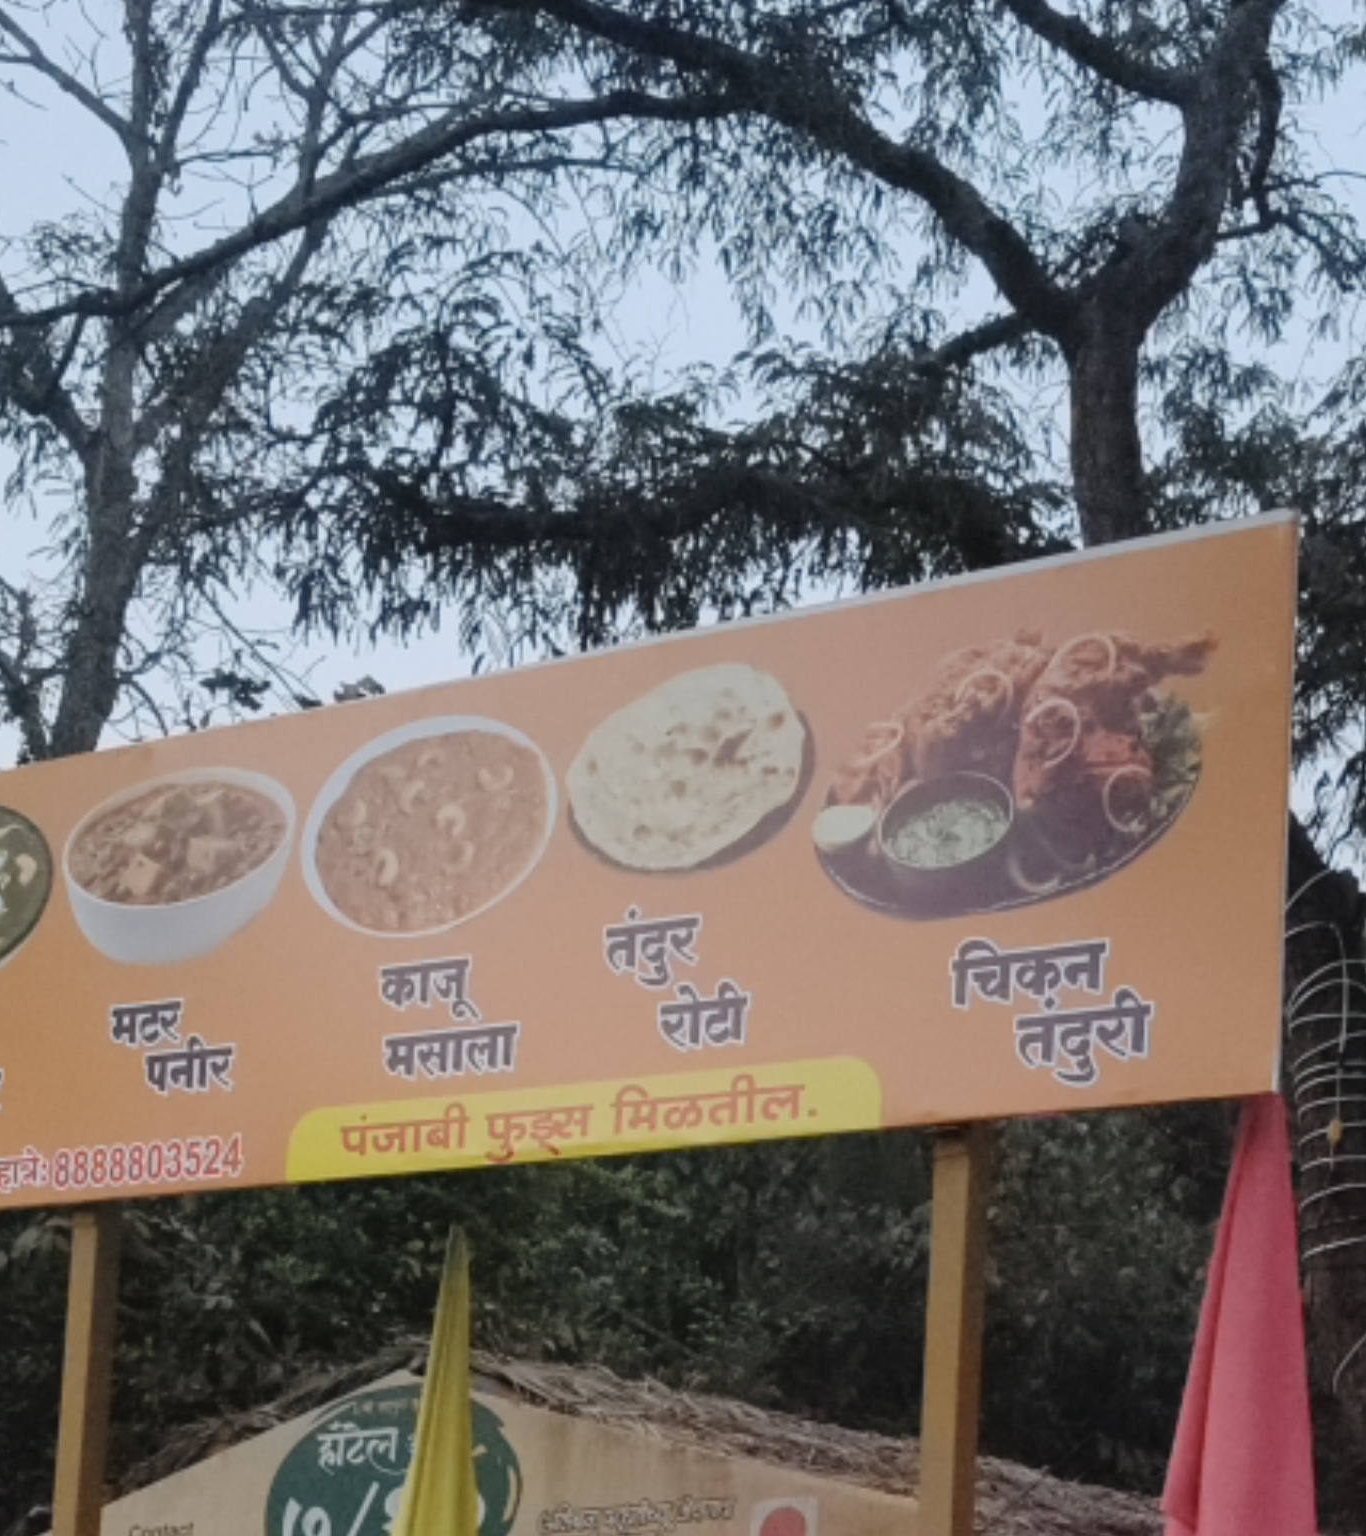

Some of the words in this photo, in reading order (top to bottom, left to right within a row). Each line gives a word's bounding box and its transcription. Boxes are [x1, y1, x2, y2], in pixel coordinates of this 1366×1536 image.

[606, 908, 701, 986] तंदुर
[951, 939, 1107, 1006] चिकन
[381, 957, 480, 1021] काजू
[659, 981, 749, 1048] रोटी
[111, 1000, 182, 1044] मटर
[384, 1023, 519, 1078] मसाला
[146, 1036, 234, 1092] पनीर
[340, 1103, 470, 1157] पंजाबी
[612, 1074, 818, 1136] मिळतील.
[54, 1134, 243, 1189] 8888803524
